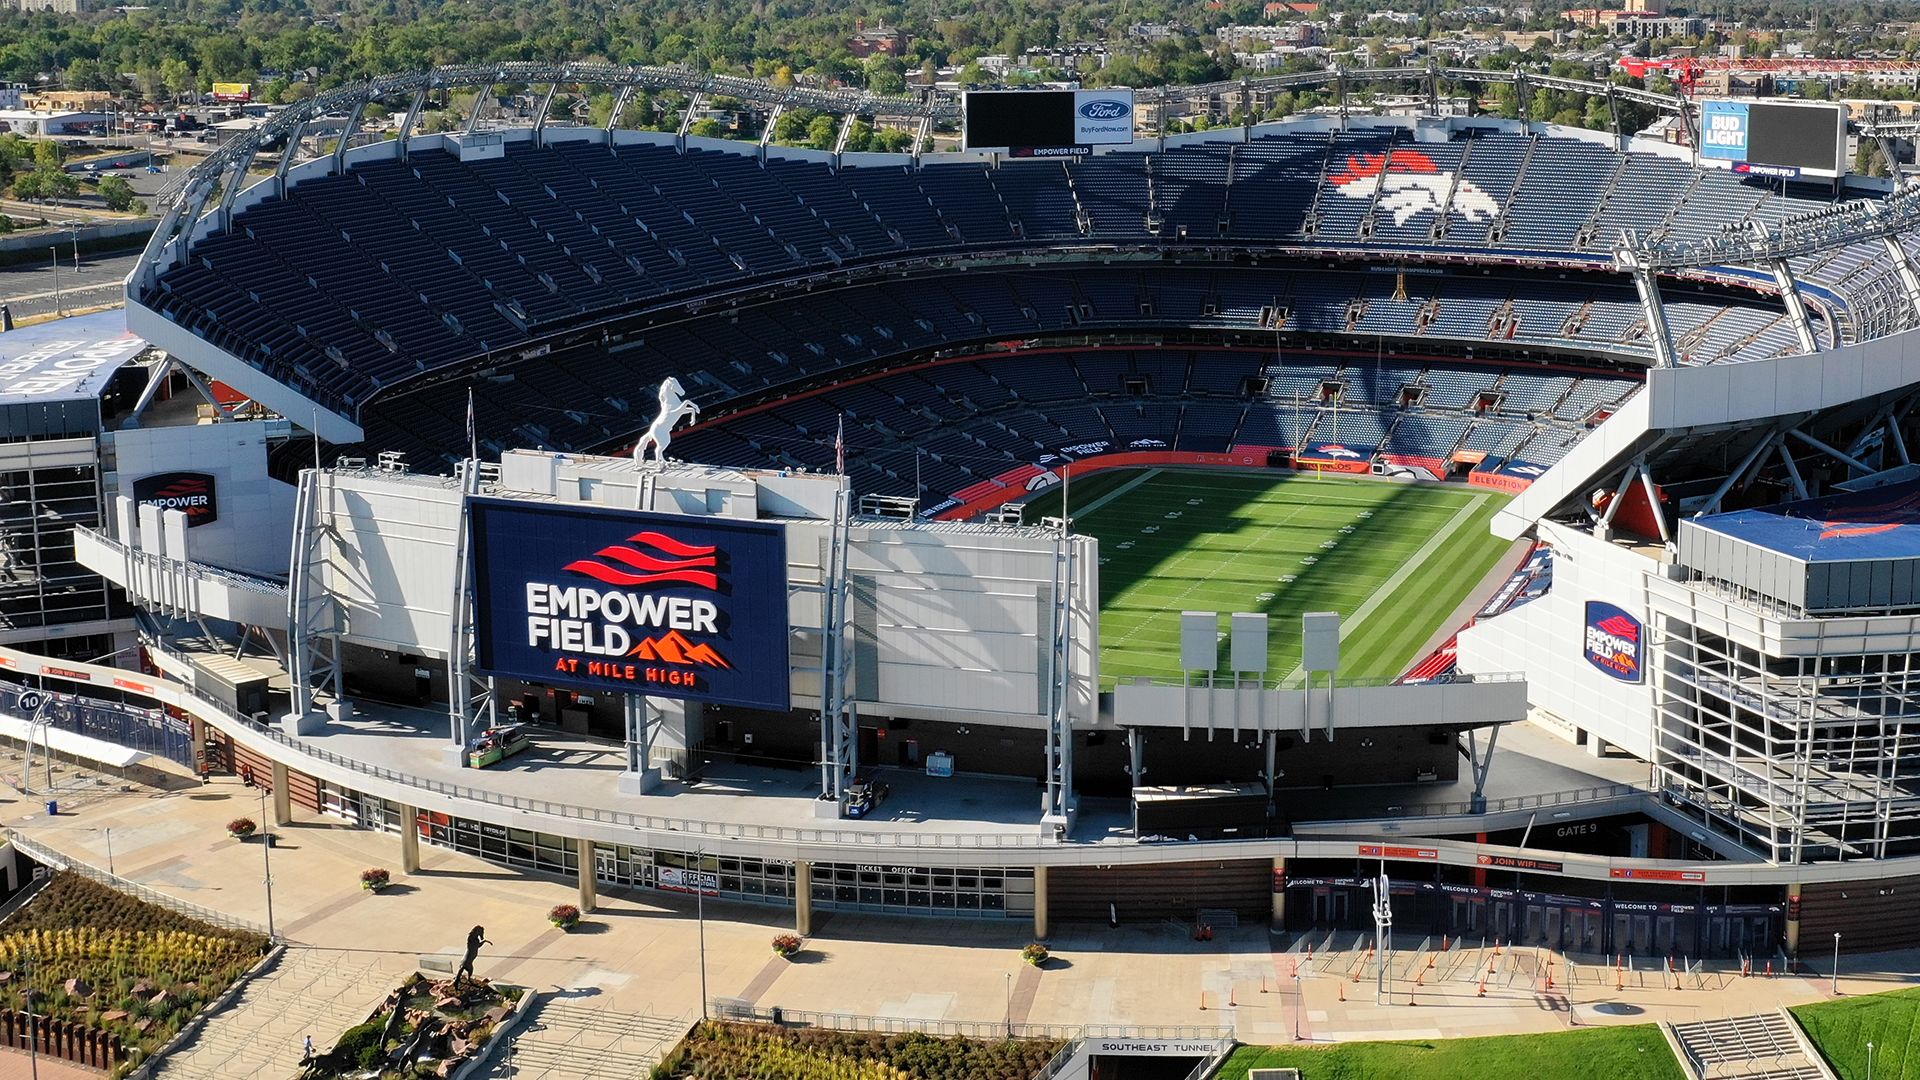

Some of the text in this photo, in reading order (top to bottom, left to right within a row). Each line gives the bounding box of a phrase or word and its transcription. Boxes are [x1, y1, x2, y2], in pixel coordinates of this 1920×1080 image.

[1088, 101, 1121, 118] Ford
[1080, 126, 1129, 134] BuyFordNow.com
[1711, 115, 1740, 132] BUD
[1706, 129, 1745, 146] LIGHT
[1033, 147, 1089, 156] EMPOWER FIELD
[1749, 165, 1778, 176] EMPOWER
[1060, 440, 1111, 454] EMPOWER
[1076, 446, 1104, 456] FIELD
[526, 582, 718, 633] EMPOWER
[528, 616, 631, 656] FIELD
[1586, 625, 1636, 658] EMPOWER
[1586, 638, 1613, 658] FIELD
[555, 657, 696, 687] AT MILE HIGH
[22, 696, 39, 708] 10
[1556, 823, 1598, 837] GATE 9
[857, 865, 882, 873] TICKET
[1494, 857, 1515, 866] JOIN
[1517, 859, 1537, 868] WIFI
[1441, 885, 1469, 893] WELCOME
[1101, 1043, 1217, 1052] SOUTHEAST TUNNEL
